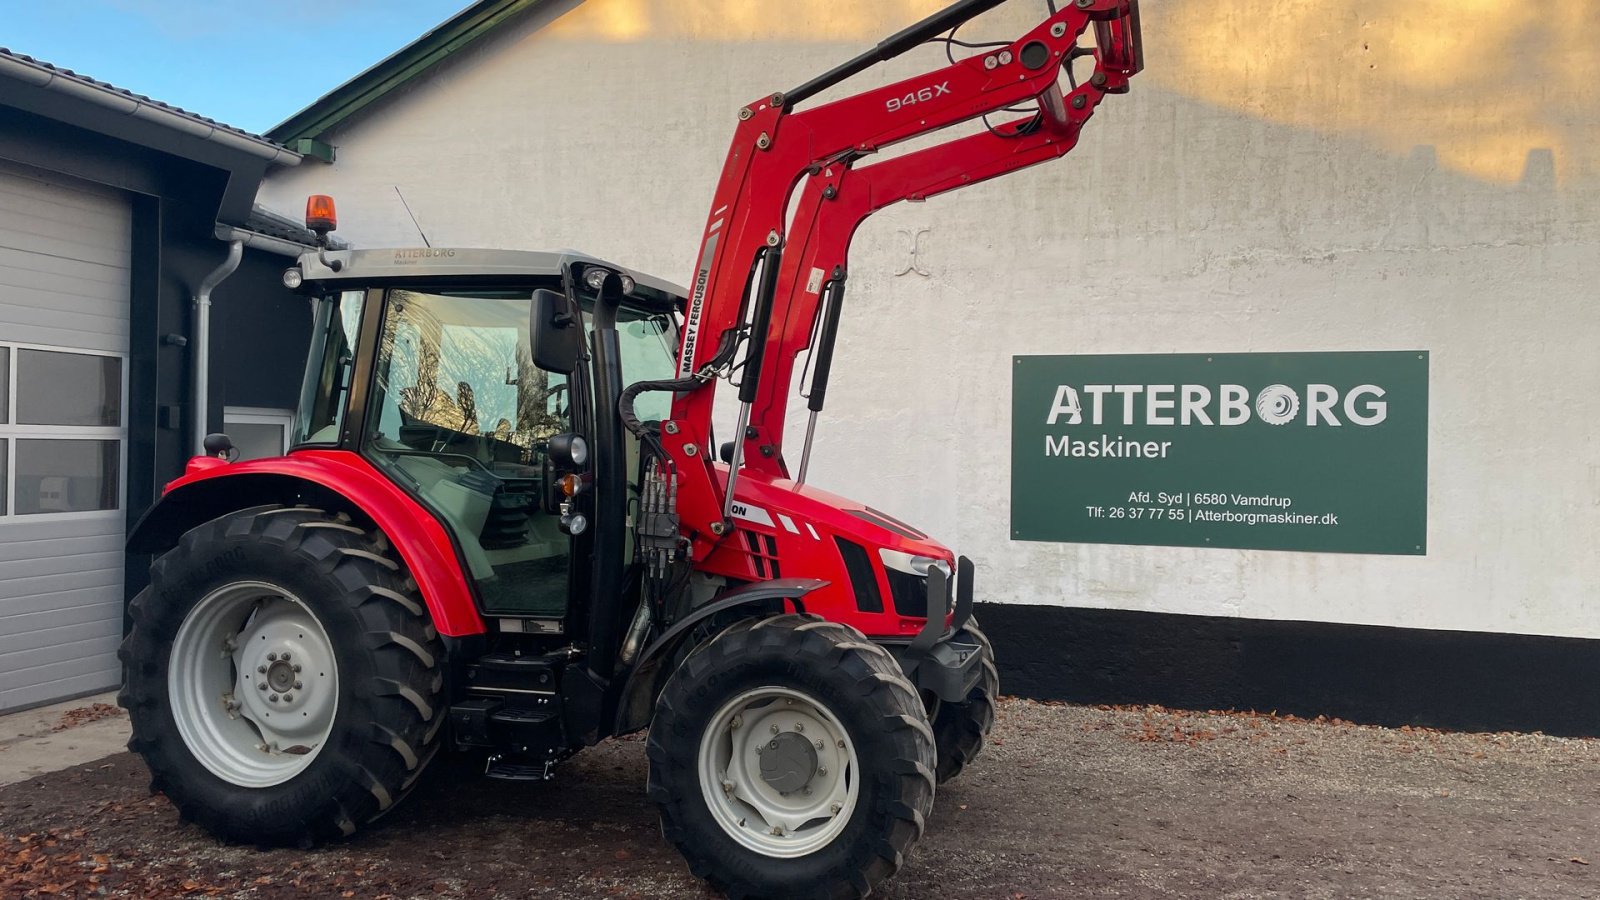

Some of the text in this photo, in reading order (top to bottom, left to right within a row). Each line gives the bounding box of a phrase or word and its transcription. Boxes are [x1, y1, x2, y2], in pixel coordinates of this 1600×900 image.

[886, 81, 951, 112] 946X
[394, 248, 455, 258] ATTERBORG
[683, 269, 708, 373] MASSEY FERGUSON
[1046, 384, 1387, 426] ATTERBORG
[1045, 434, 1172, 458] Maskiner
[1128, 491, 1153, 503] Afd.
[1158, 492, 1183, 506] Syd
[1194, 493, 1227, 505] 6580
[1231, 494, 1291, 509] Vamdrup
[1109, 507, 1125, 518] 26
[1129, 508, 1144, 519] 37
[1148, 508, 1165, 519] 77
[1168, 509, 1184, 520] 55
[1195, 510, 1338, 525] Atterborgmaskiner.dk
